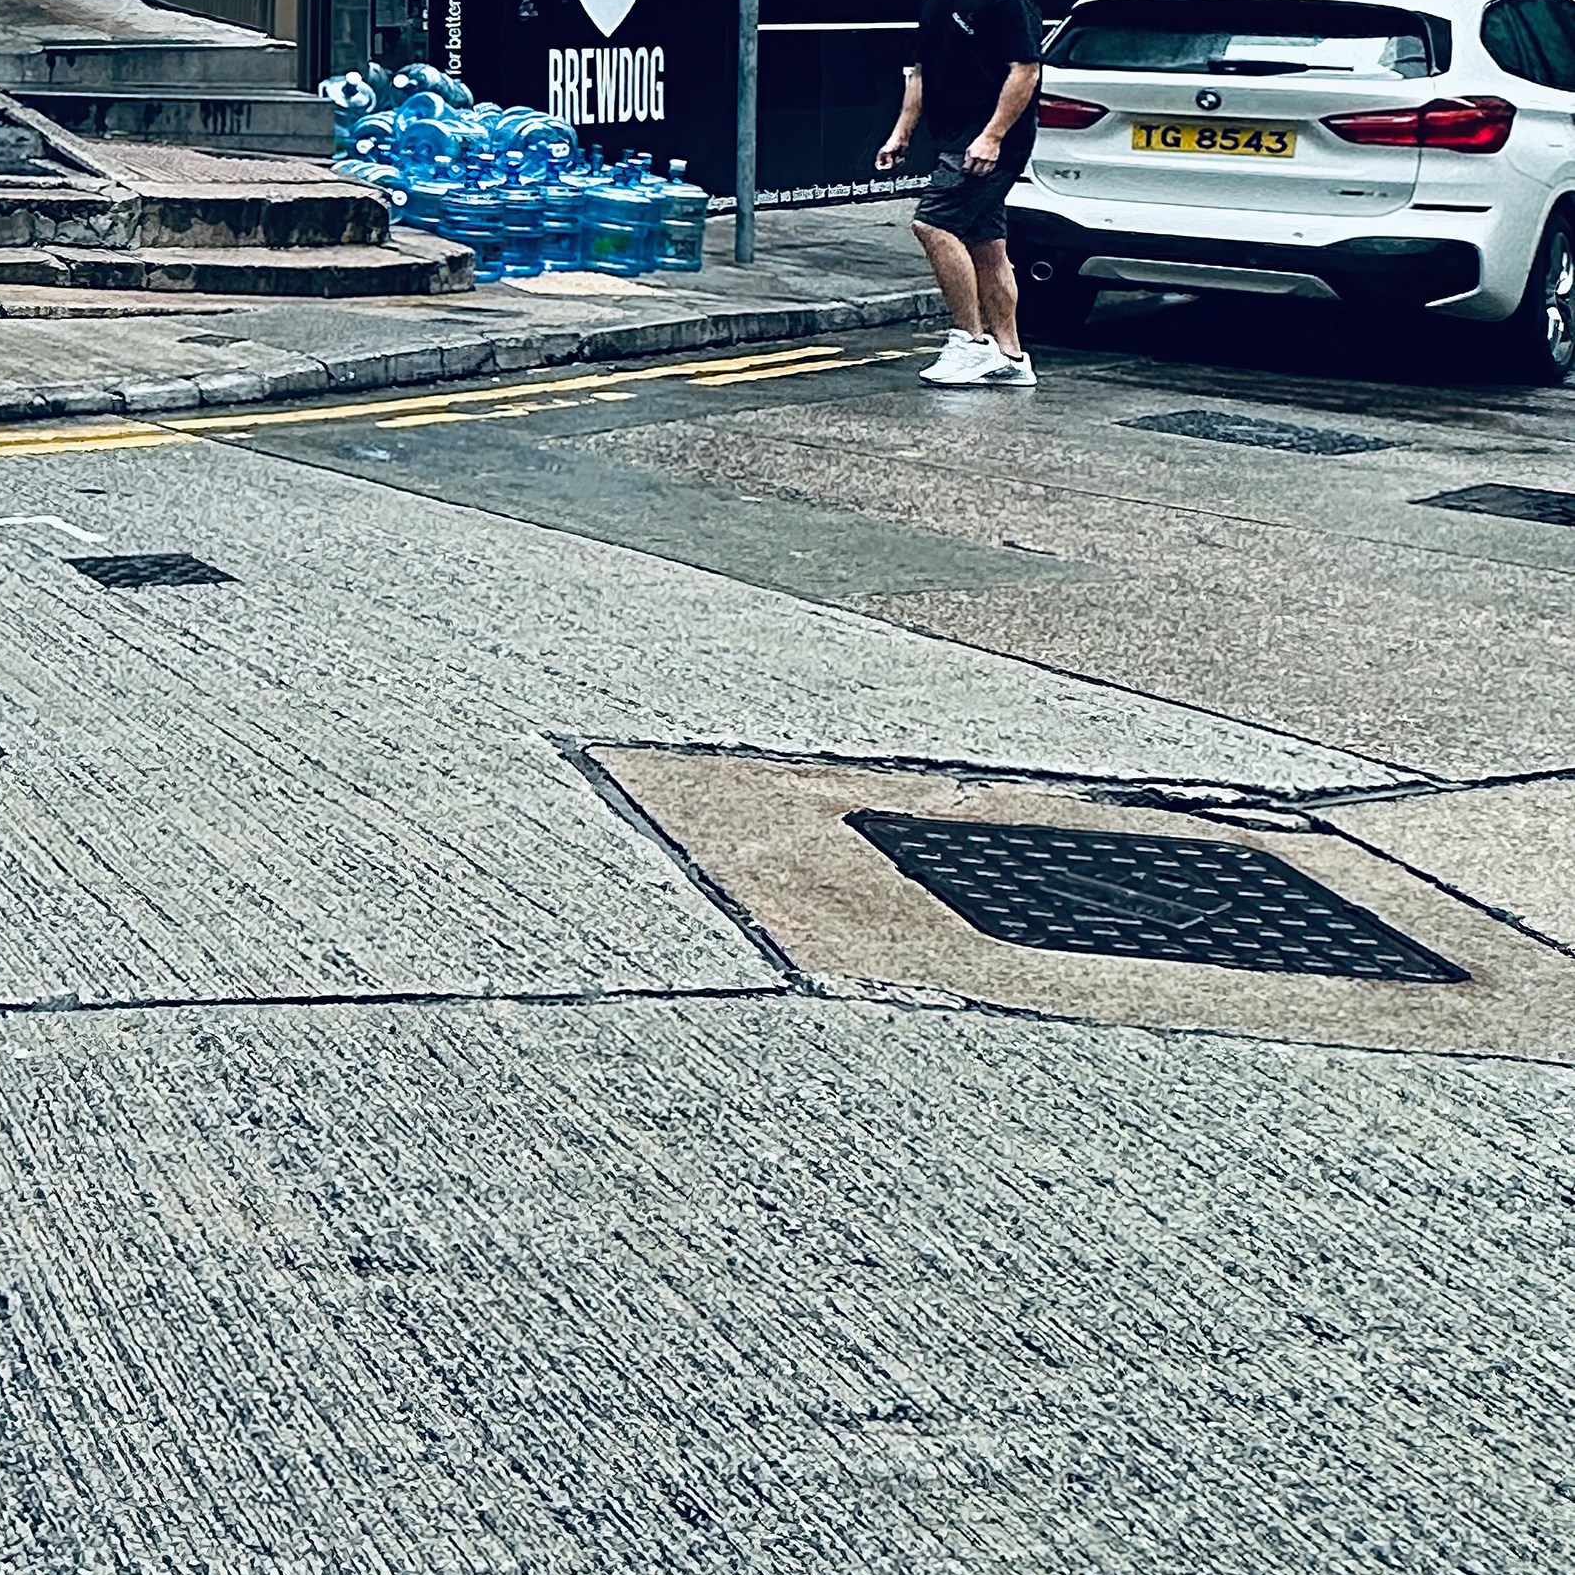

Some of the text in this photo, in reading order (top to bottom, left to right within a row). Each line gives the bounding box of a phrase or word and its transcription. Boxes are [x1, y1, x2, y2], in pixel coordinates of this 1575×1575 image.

[445, 0, 462, 50] better
[549, 46, 665, 125] BREWDOG
[1139, 125, 1290, 154] TG 8543
